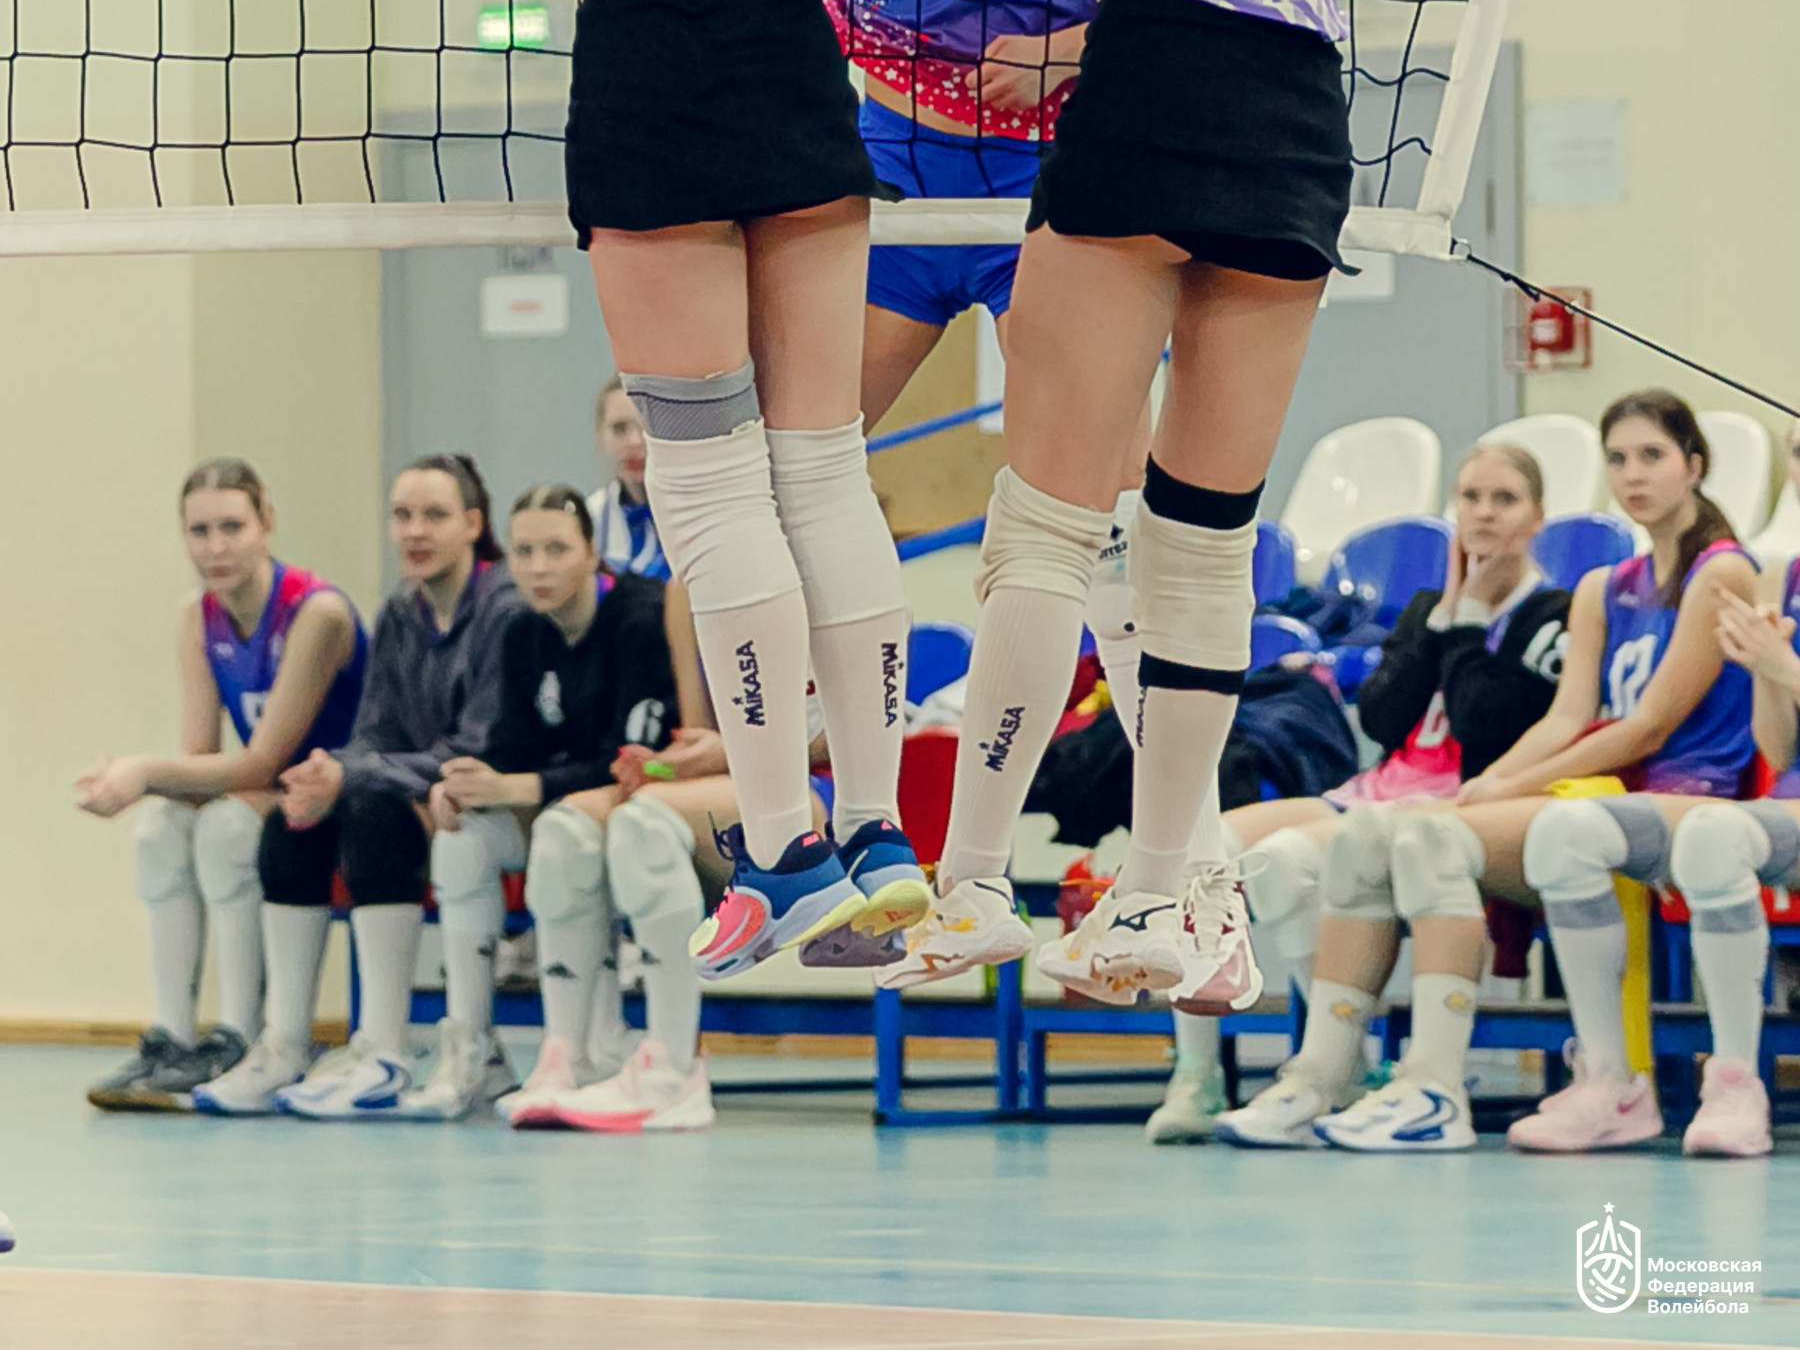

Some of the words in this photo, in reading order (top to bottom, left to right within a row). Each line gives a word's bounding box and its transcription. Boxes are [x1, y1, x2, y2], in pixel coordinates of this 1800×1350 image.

[732, 640, 766, 727] MIKASA
[881, 642, 904, 728] MIKASA
[979, 706, 1026, 772] MIKASA
